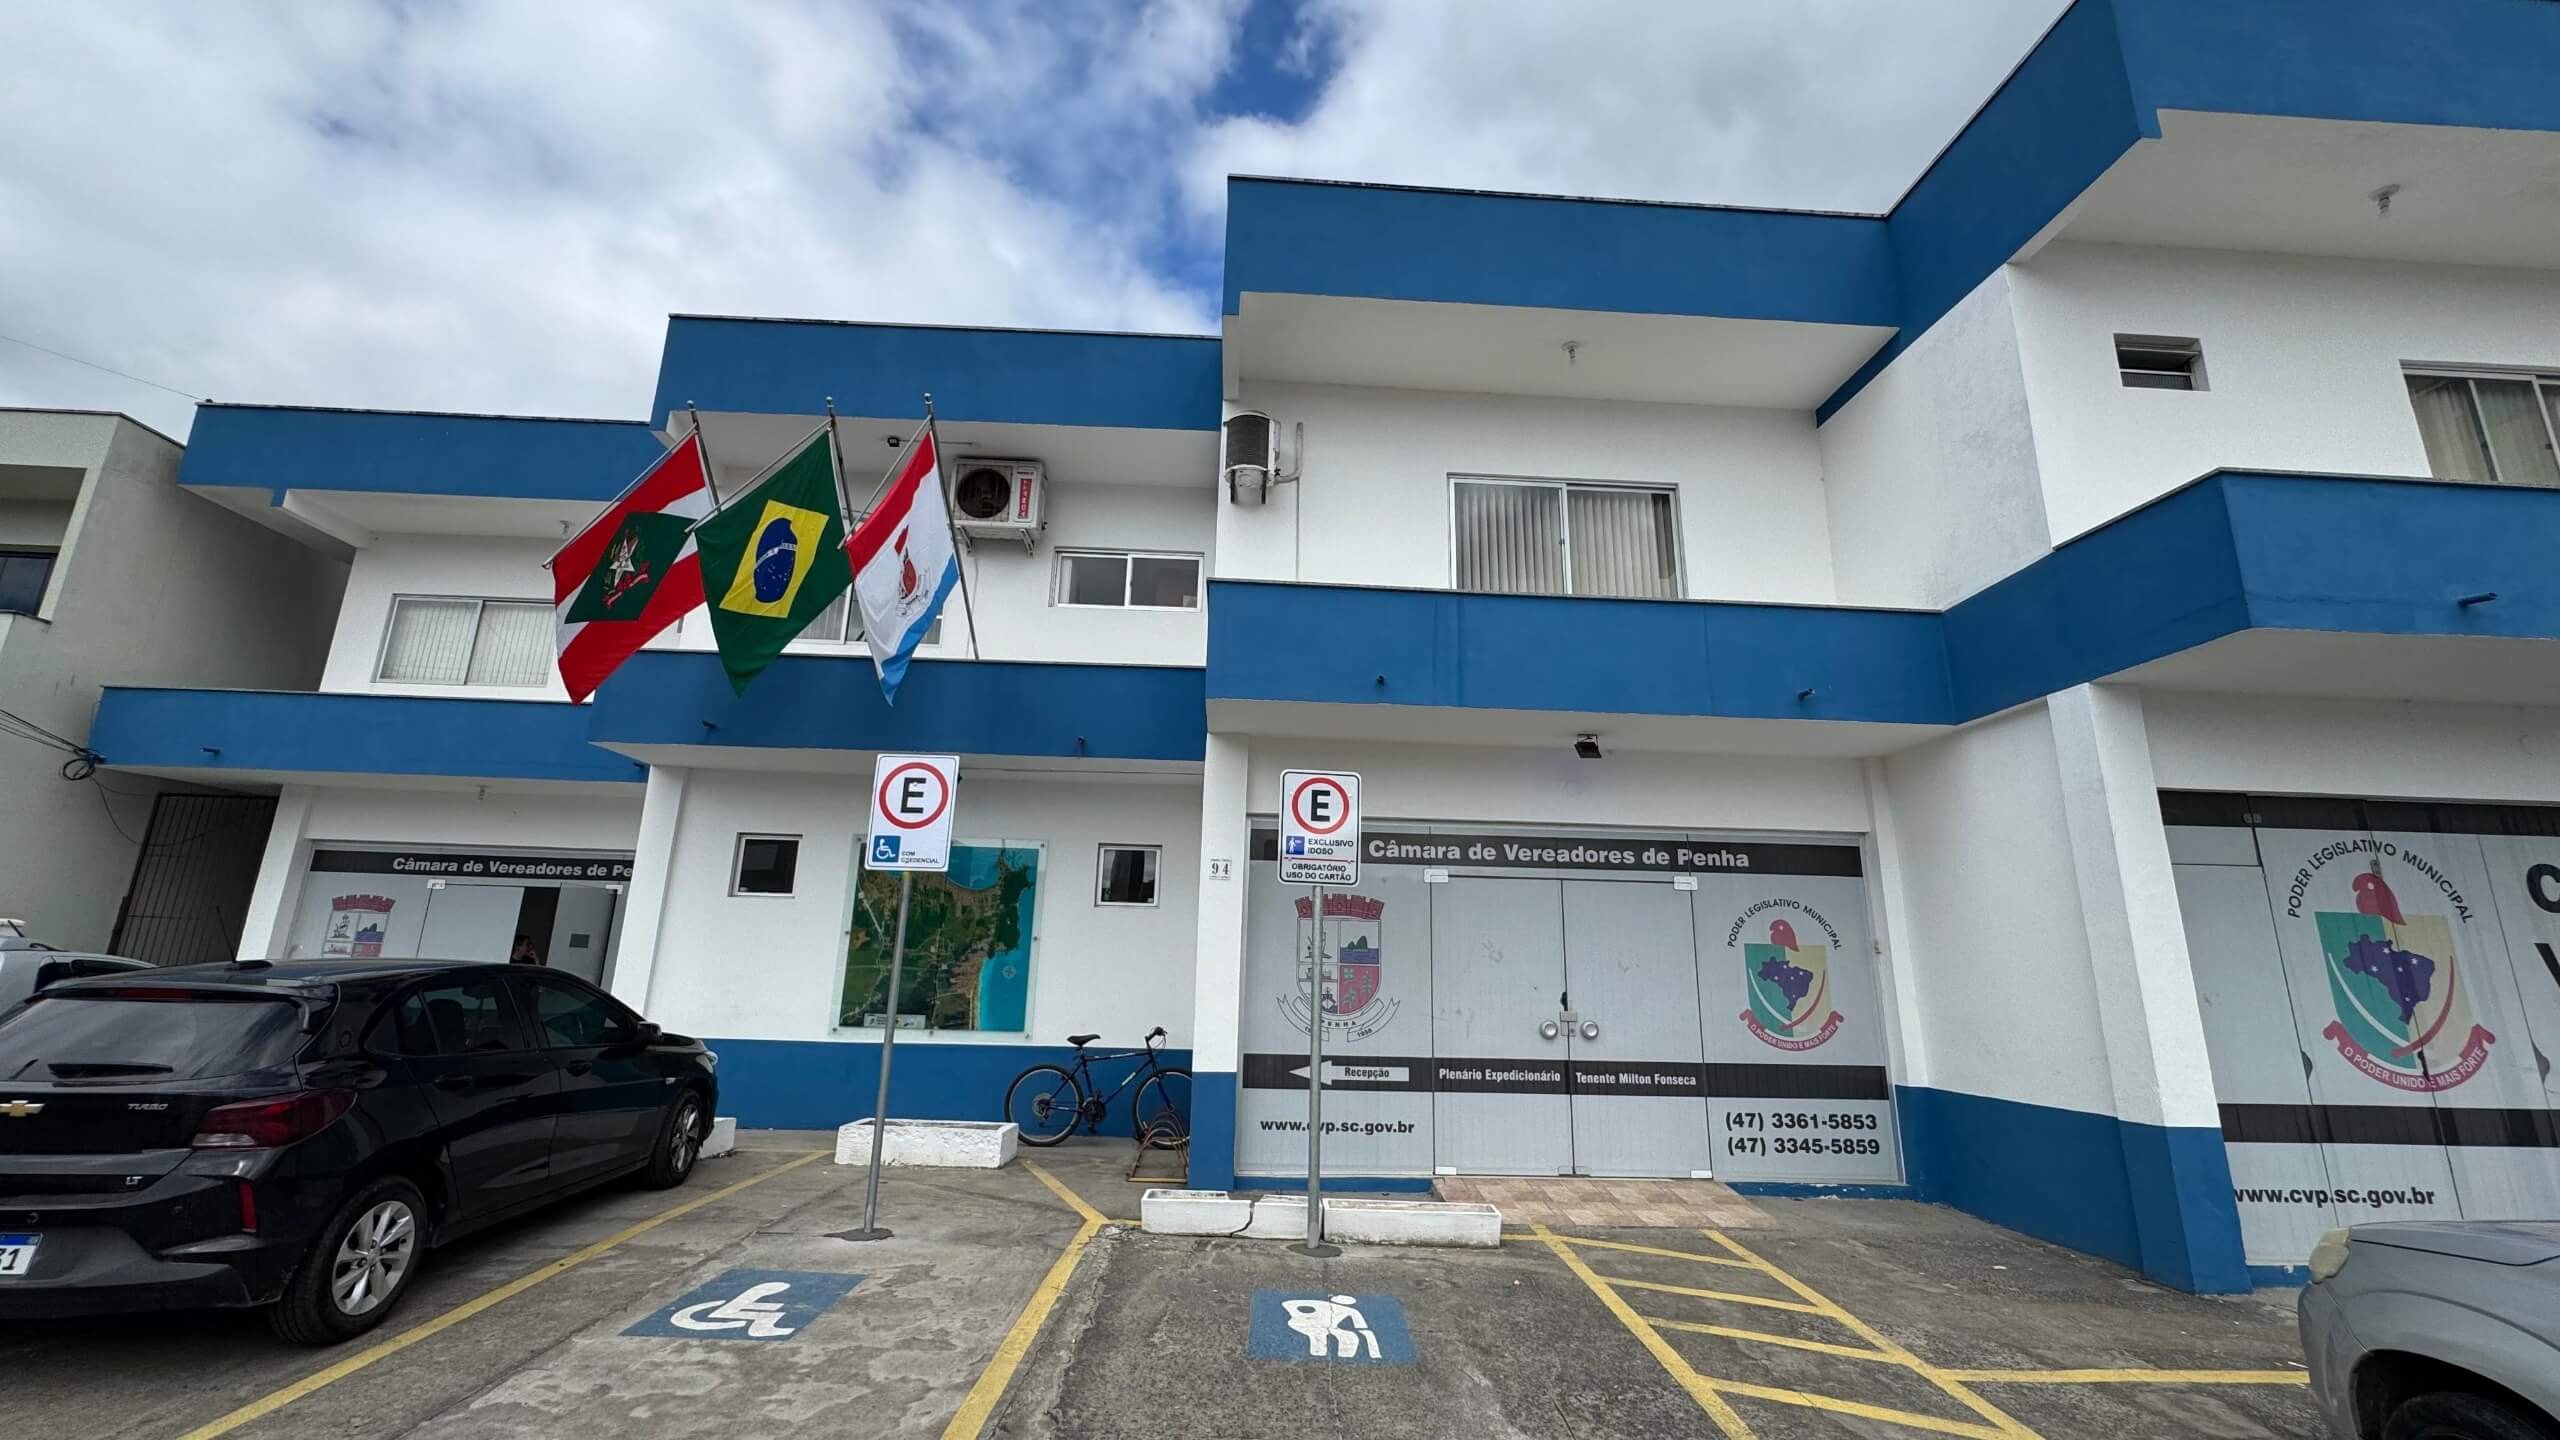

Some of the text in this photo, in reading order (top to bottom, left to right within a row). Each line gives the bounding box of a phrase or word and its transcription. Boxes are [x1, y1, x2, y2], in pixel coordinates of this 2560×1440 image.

[900, 777, 927, 813] E
[1311, 789, 1331, 822] E
[1307, 847, 1334, 855] IDOSO
[1308, 838, 1354, 847] EXCLUSIVO
[1368, 839, 1750, 868] Câmara de Vereadores de Penha
[392, 857, 458, 872] Câmara
[463, 860, 484, 873] de
[489, 861, 582, 876] Vereadores
[586, 863, 607, 877] de
[1291, 862, 1346, 872] OBRIGATÓRIO
[1305, 872, 1317, 880] DO
[1318, 872, 1352, 881] CARTÃO
[2287, 839, 2474, 924] PODER LEGISLATIVO MUNICIPAL
[1727, 898, 1843, 951] PODER LEGISLATIVO MUNICIPAL
[1439, 1068, 1697, 1086] Plenário Expedicionário Tenente Milton Fonseca
[2344, 1047, 2354, 1057] O
[2353, 1055, 2390, 1081] PODER
[2391, 1074, 2426, 1089] UNIDO
[2436, 1069, 2462, 1086] MAIS
[2459, 1047, 2486, 1077] FORTE
[1725, 1112, 1877, 1132] (47) 3361-5853
[1728, 1136, 1880, 1157] (47) 3345-5859
[126, 1176, 144, 1185] LT
